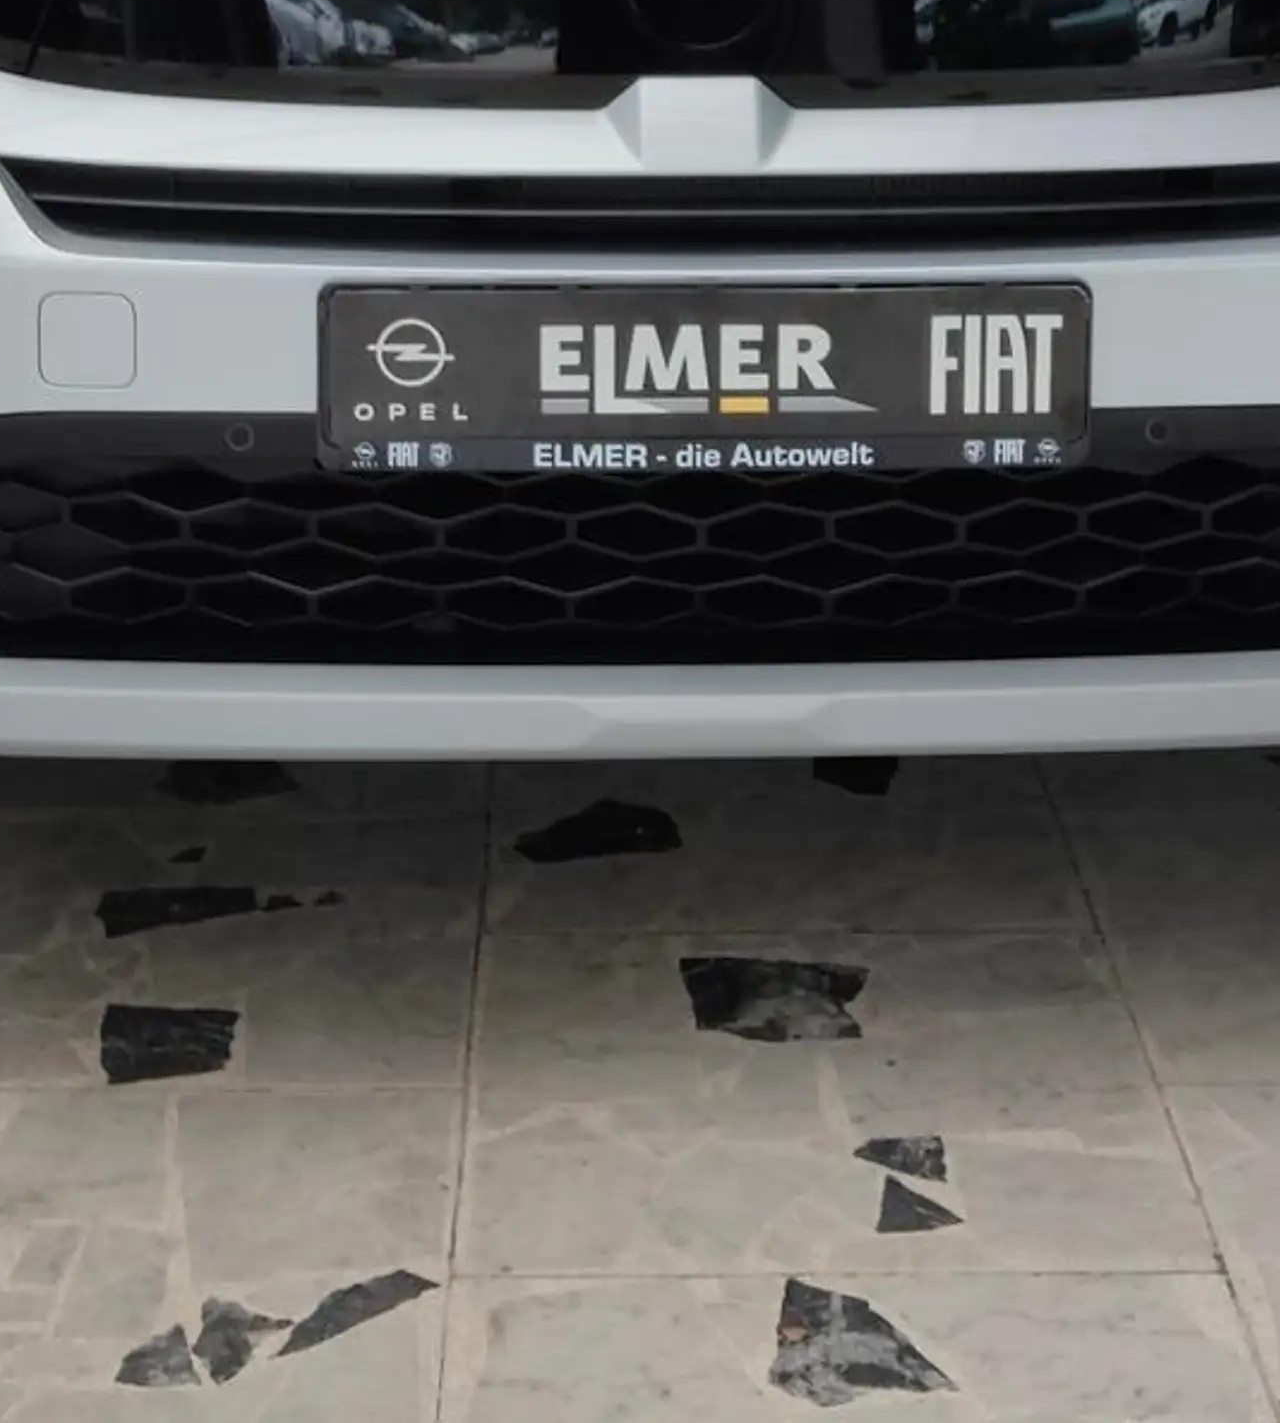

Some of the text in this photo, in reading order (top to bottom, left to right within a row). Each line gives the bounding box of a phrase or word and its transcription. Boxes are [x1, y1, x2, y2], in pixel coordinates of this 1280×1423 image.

[538, 323, 838, 415] ELMER
[928, 313, 1064, 416] FIAT
[353, 402, 469, 422] OPEL
[387, 441, 420, 468] FIAT
[532, 442, 648, 468] ELMER
[675, 443, 721, 468] die
[730, 441, 875, 468] Autowelt
[993, 438, 1026, 466] FIAT
